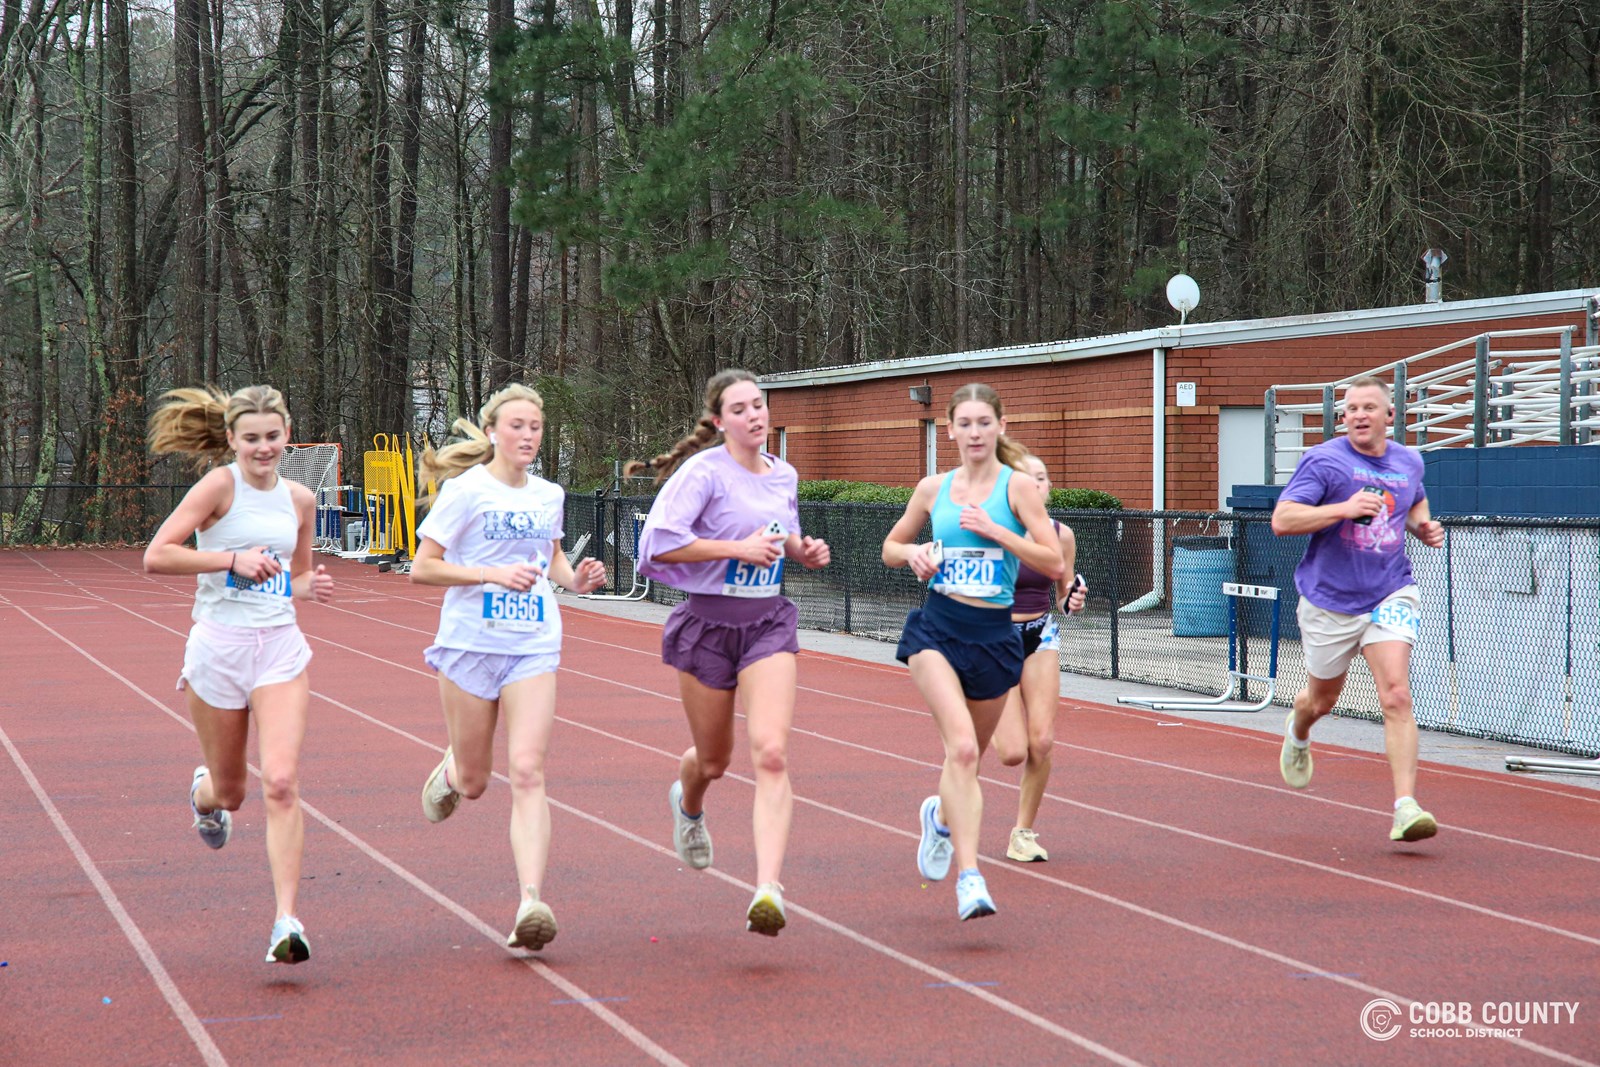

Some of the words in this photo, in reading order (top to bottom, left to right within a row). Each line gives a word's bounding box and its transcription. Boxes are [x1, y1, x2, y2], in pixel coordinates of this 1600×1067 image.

[734, 559, 780, 586] 5767
[943, 559, 995, 585] 5820
[491, 592, 539, 621] 5656
